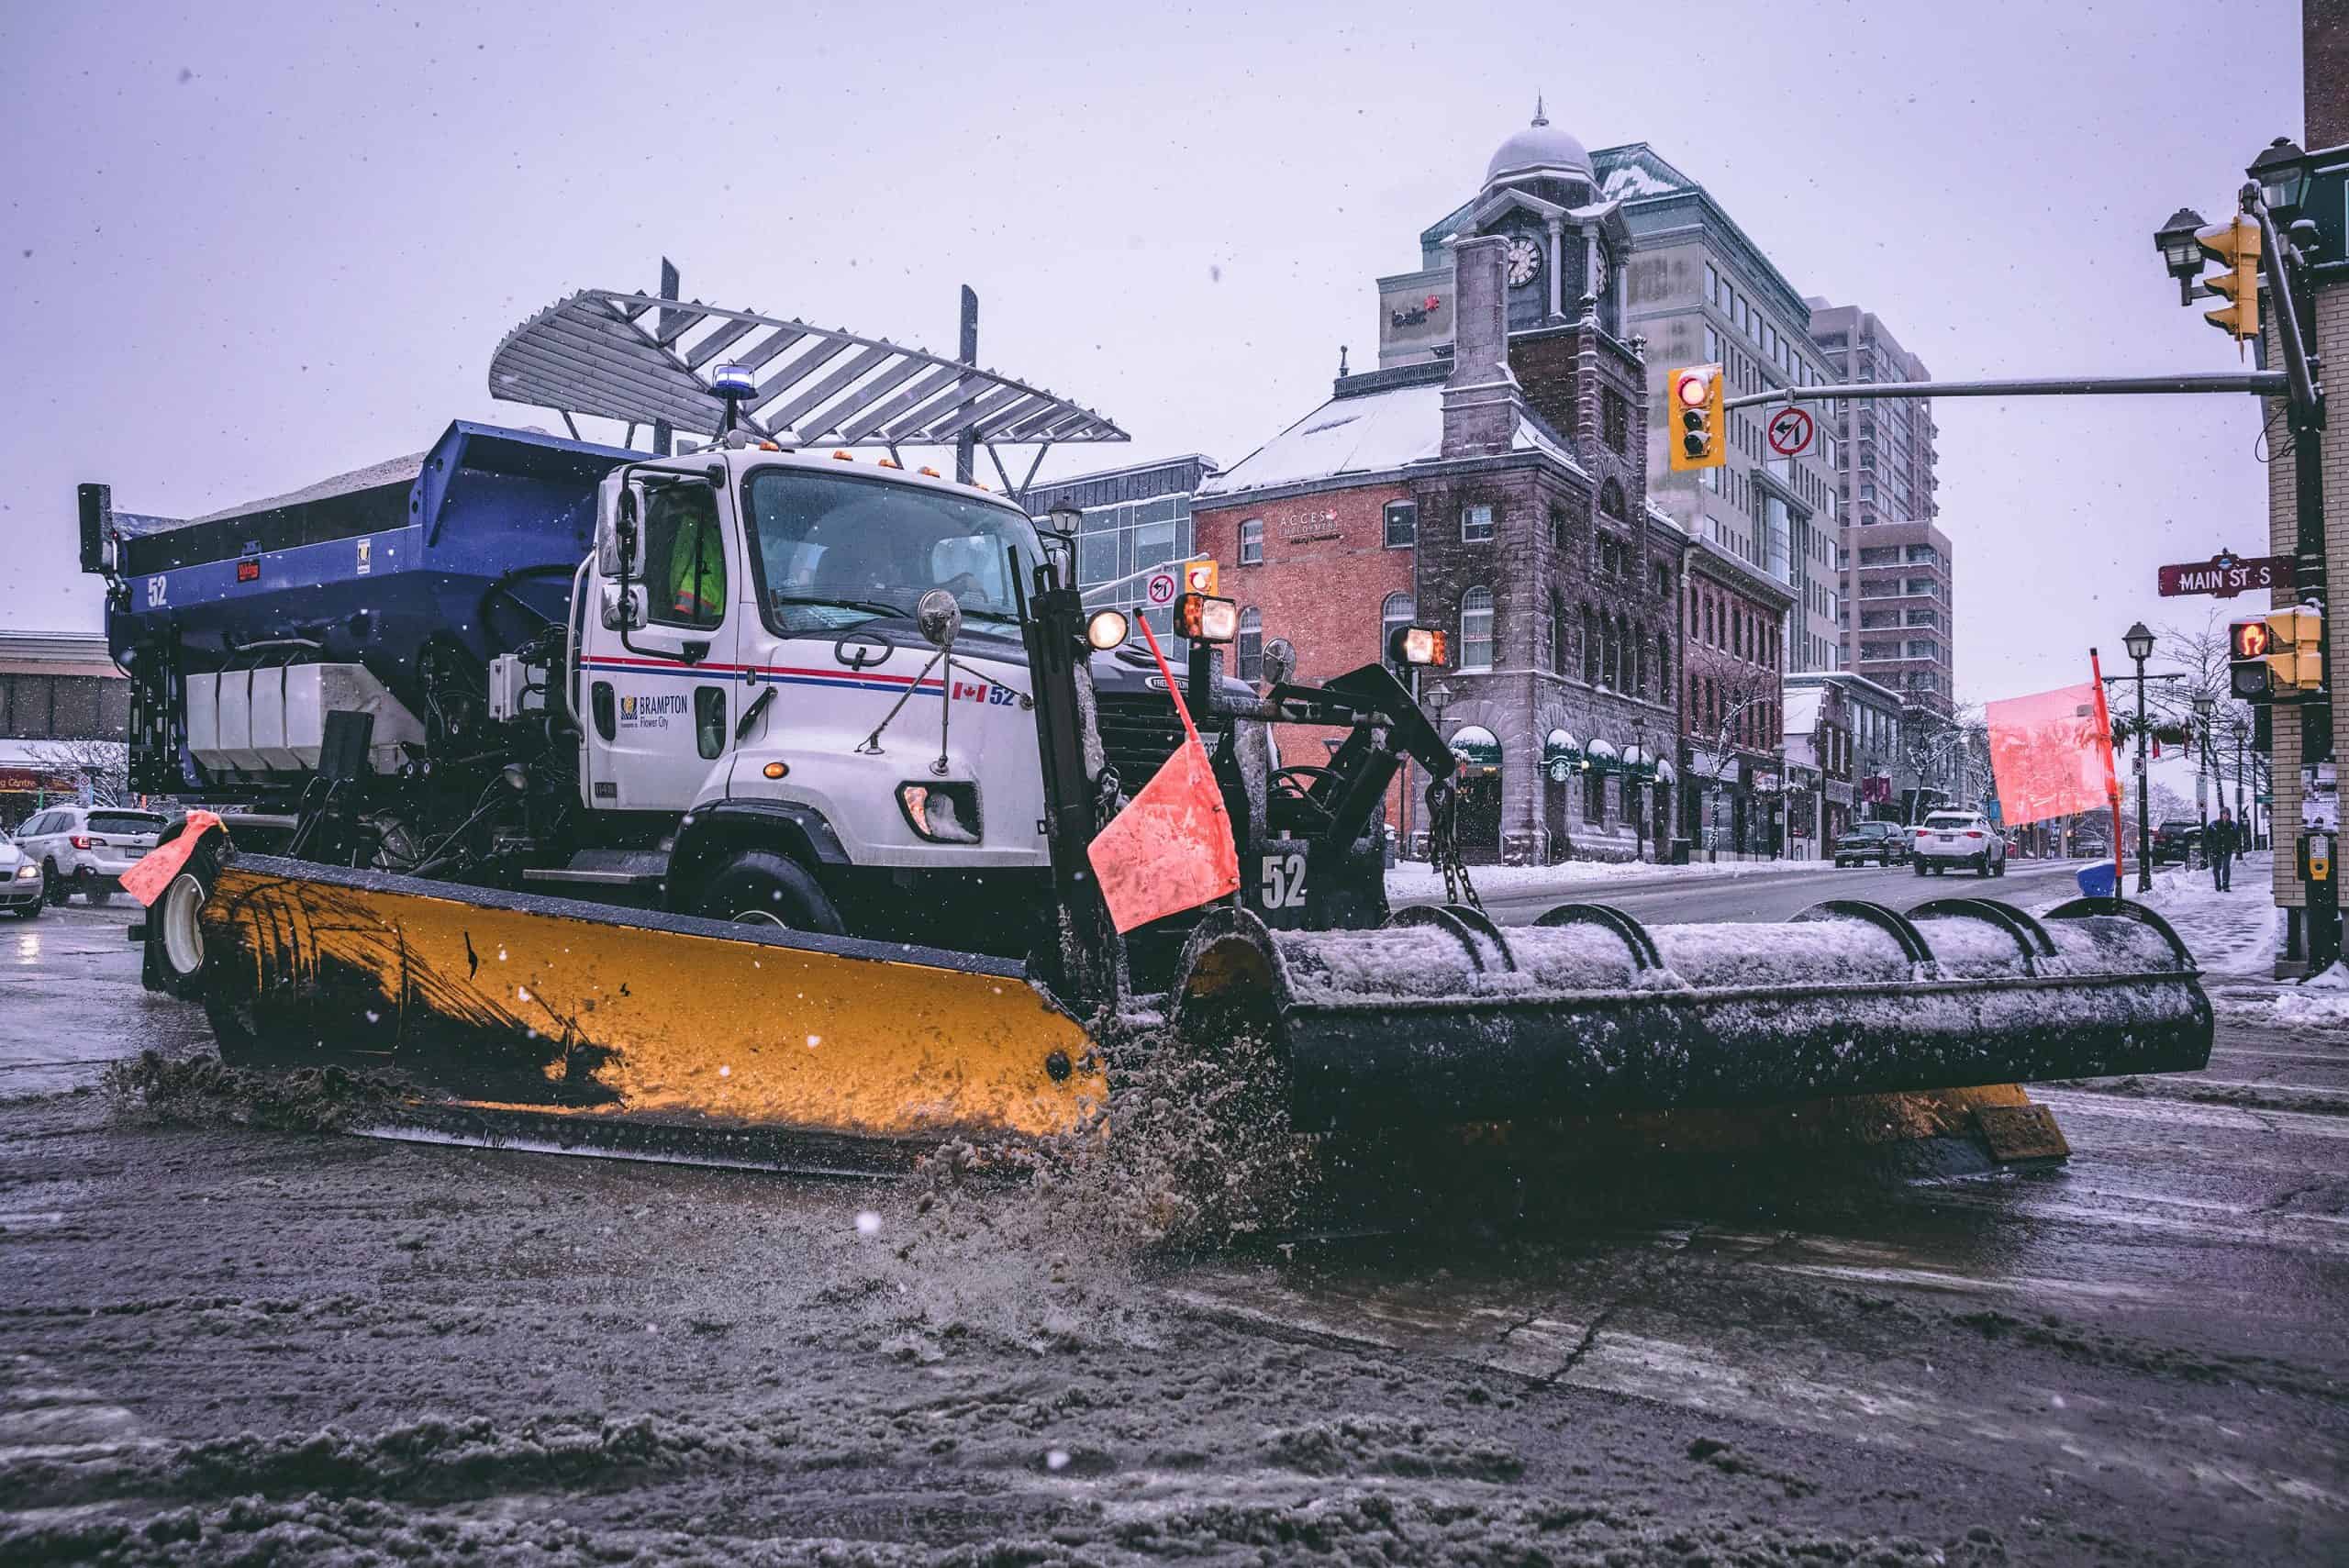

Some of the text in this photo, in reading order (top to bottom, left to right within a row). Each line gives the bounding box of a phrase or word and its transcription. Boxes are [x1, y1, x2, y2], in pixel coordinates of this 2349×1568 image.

[2180, 566, 2271, 591] MAIN ST S
[148, 575, 167, 607] 52
[640, 695, 687, 715] BRAMPTON
[989, 685, 1015, 706] 52
[640, 716, 669, 731] Flower City
[1262, 853, 1307, 909] 52
